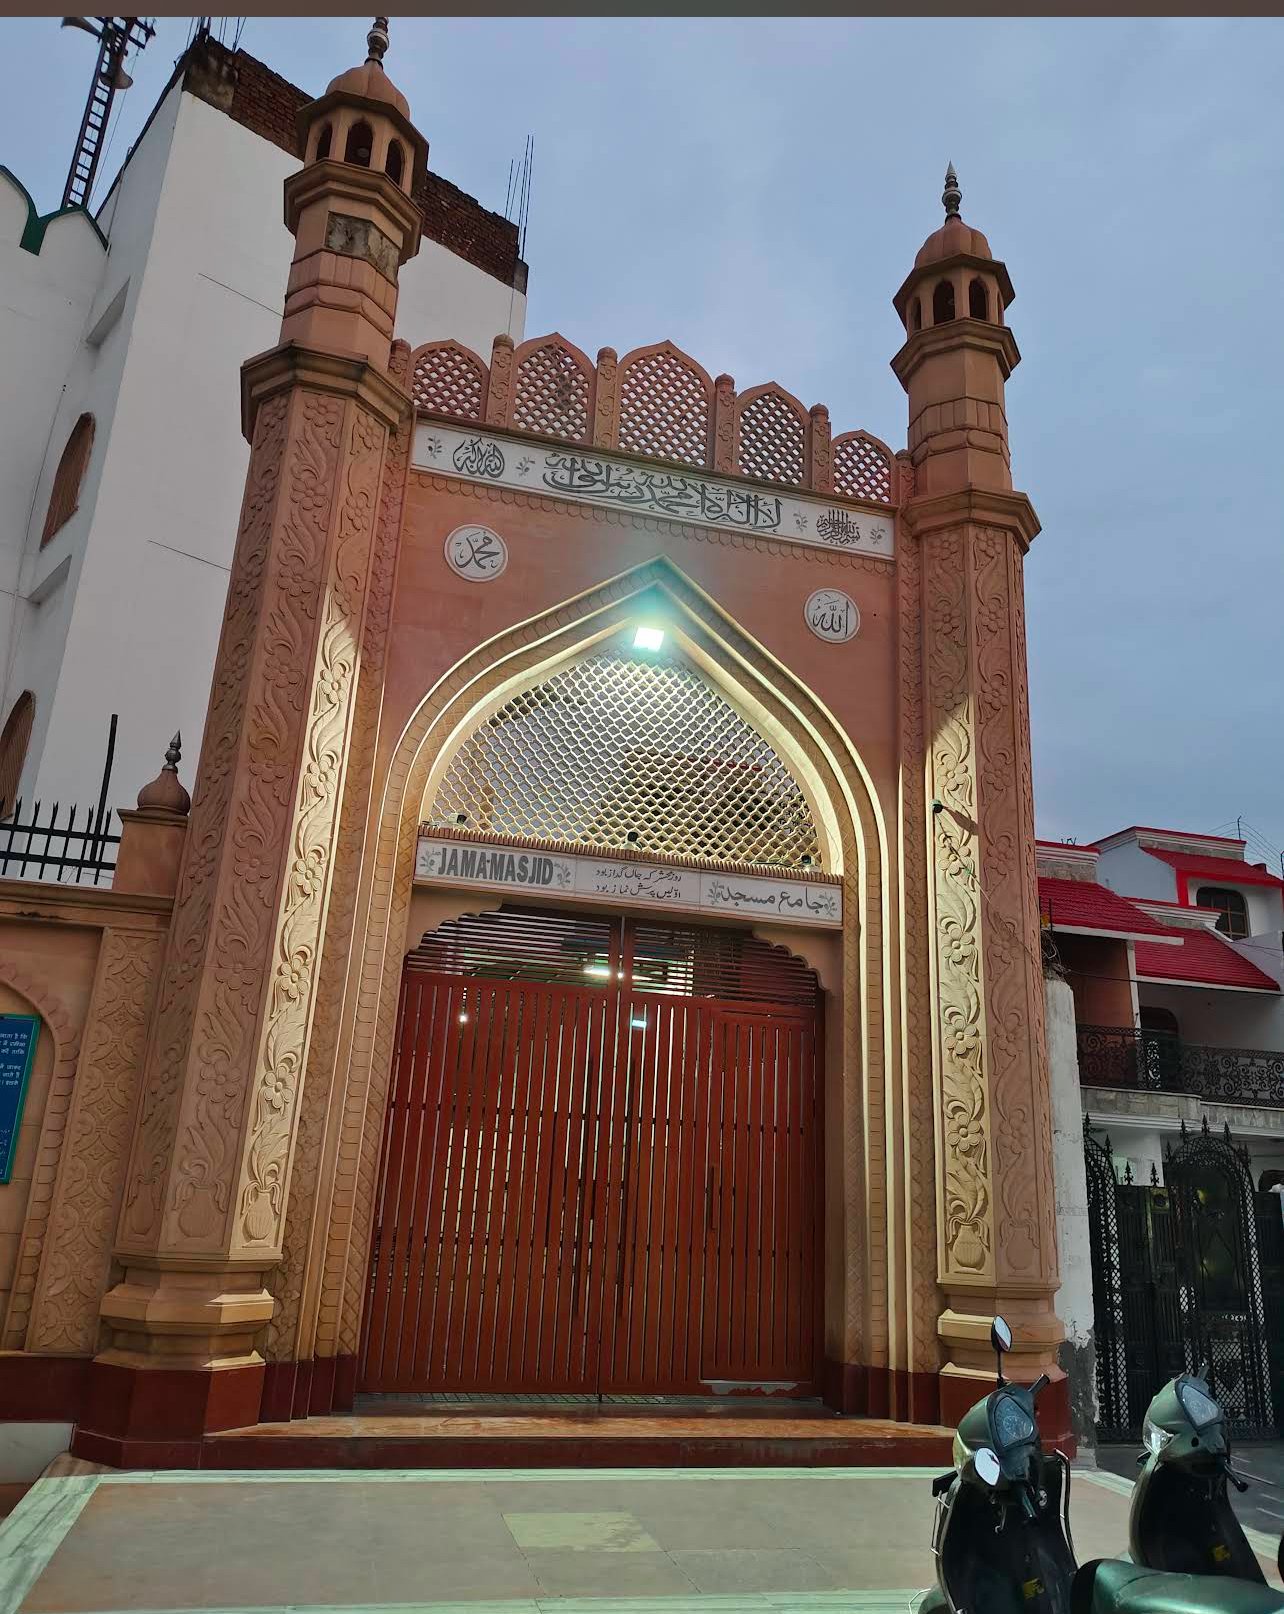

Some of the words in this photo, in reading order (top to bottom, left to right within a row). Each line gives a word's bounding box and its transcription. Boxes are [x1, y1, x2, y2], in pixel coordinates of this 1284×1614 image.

[812, 594, 850, 638] الله
[720, 886, 776, 907] مسجد
[778, 886, 824, 913] جامع
